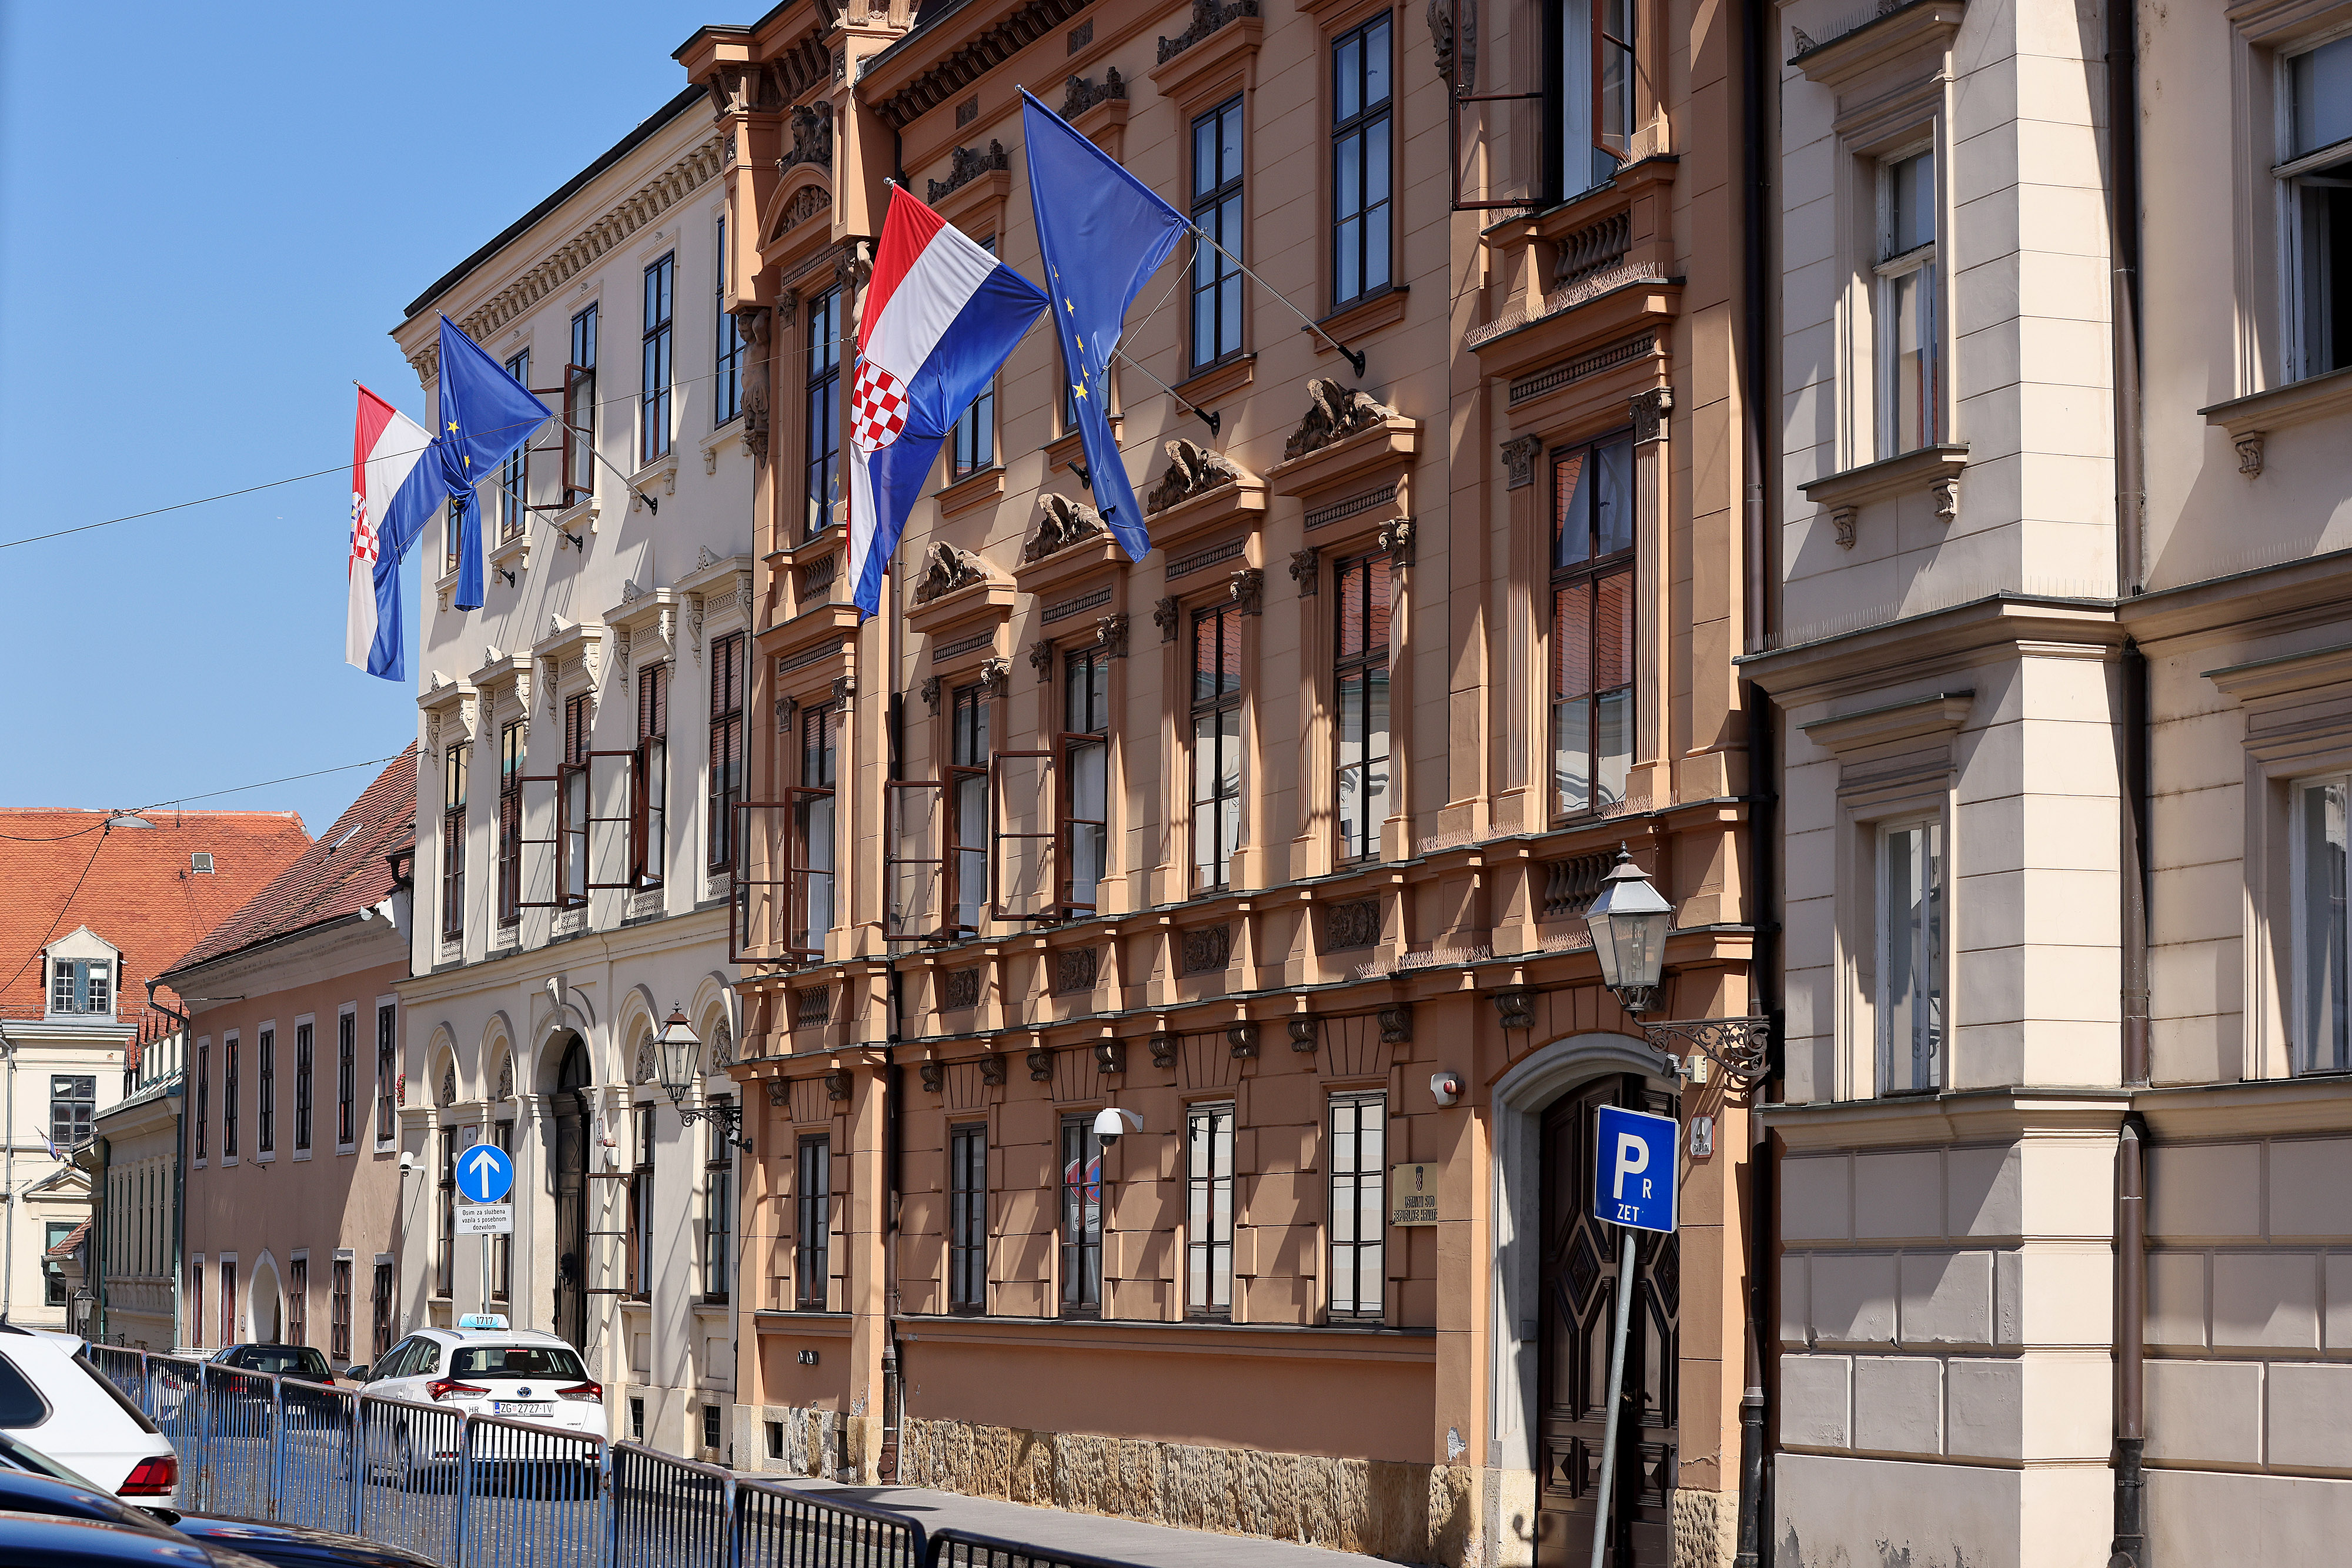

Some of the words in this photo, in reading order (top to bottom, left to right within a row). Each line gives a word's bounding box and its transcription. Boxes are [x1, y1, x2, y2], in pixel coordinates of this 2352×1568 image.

[1696, 1117, 1704, 1143] 4
[1613, 1132, 1650, 1200] P
[1642, 1178, 1652, 1199] R
[1405, 1196, 1424, 1208] USTAVNI
[1425, 1195, 1435, 1208] SUD
[1394, 1210, 1419, 1222] REPUBLIKE
[1616, 1203, 1640, 1222] ZET
[482, 1216, 507, 1224] posebnom
[476, 1316, 493, 1325] 1717
[500, 1403, 512, 1413] ZG
